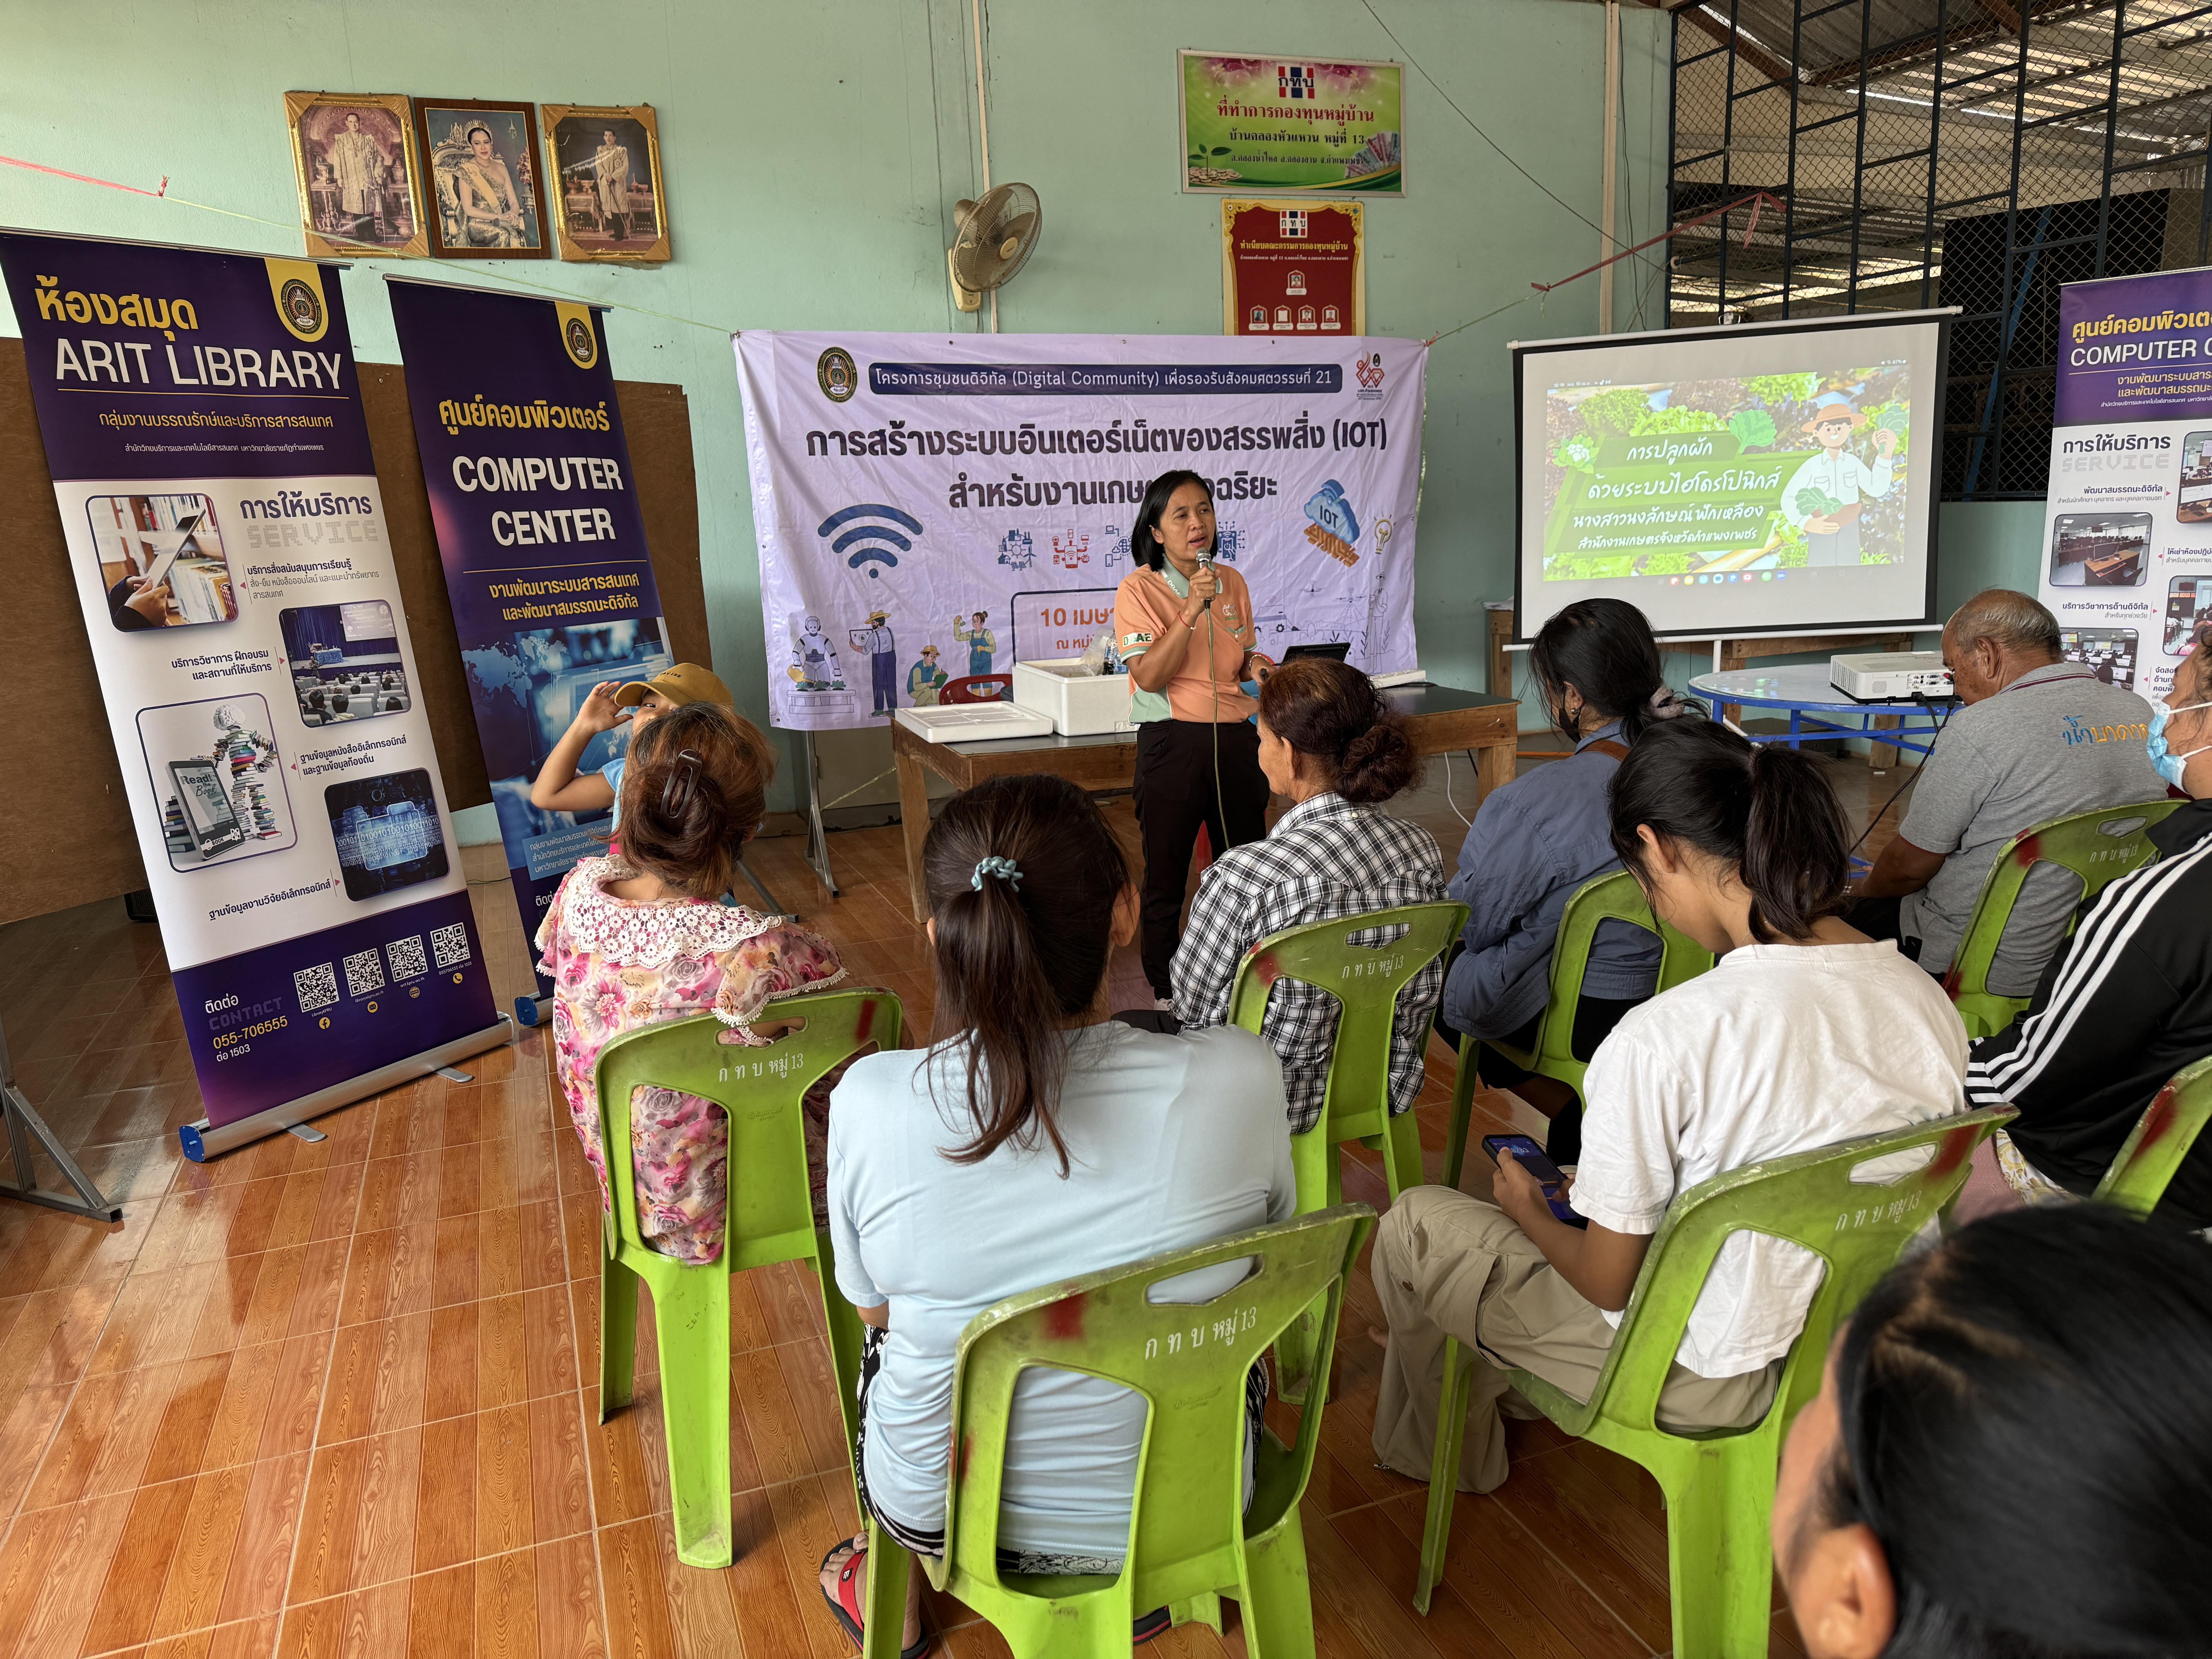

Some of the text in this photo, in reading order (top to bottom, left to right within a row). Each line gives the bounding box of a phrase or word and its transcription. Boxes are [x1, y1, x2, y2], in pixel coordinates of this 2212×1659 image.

[1278, 76, 1314, 88] กทบ
[1217, 94, 1374, 126] ที่ทำการกองทุนหมู่บ้าน
[1229, 127, 1365, 148] บ้านคลองหัวแหวน หมู่ที่ 13
[1240, 239, 1348, 252] ทำเนียบคณะกรรมการกองทุนหมู่บ้าน
[35, 275, 199, 341] ห้องสมุด
[2073, 310, 2212, 343] ศูนย์คอมพิวเต
[2071, 338, 2197, 366] COMPUTER
[56, 338, 341, 389] ARIT LIBRARY
[875, 368, 1331, 389] โครงการชุมชนดิจิทัล (Digital Community) เพื่อรองรับสังคมศตวรรษที่ 21
[2118, 371, 2212, 385] งานพัฒนาระบบสาร
[2118, 384, 2212, 397] และพัฒนาสมรรถนะ
[99, 409, 333, 430] กลุ่มงานบรรณรักษ์และบริการสารสนเทศ
[439, 394, 610, 435] ศูนย์คอมพิวเตอร์
[806, 410, 1386, 456] การสร้างระบบอินเตอร์เน็ตของสรรพสิ่ง (IOT)
[2063, 433, 2171, 453] การให้บริการ
[125, 443, 239, 452] สำนักวิทยบริการและเทคโนโลยีสารสนเทศ
[1627, 436, 1712, 465] การปลูกผัก
[2062, 453, 2169, 473] SERVICE
[452, 456, 624, 492] COMPUTER
[1588, 465, 1782, 499] ด้วยระบบไฮโดรโปนิกส์
[2084, 484, 2162, 494] พัฒนาสมรรถนะดิจิทัล
[240, 491, 372, 519] การให้บริการ
[1573, 503, 1693, 528] นางสาวนงลักษณ์
[491, 508, 616, 546] CENTER
[1320, 504, 1339, 529] IOT
[247, 520, 379, 548] SERVICE
[1578, 527, 1758, 550] สำนักงานเกษตรจังหวัดกำแพงเพชร
[247, 558, 352, 575] บริการสิ่งสนับสนุนการเรียนรู้
[320, 571, 380, 583] และแนะนำทรัพยากร
[253, 590, 284, 599] สารสนเทศ
[489, 573, 640, 598] งานพัฒนาระบบสารสนเทศ
[503, 592, 639, 620] และพัฒนาสมรรถนะดิจิทัล
[1040, 607, 1115, 627] 10 เมษ
[1056, 639, 1069, 649] ณ
[1123, 633, 1152, 646] DAE
[172, 650, 269, 668] บริการวิชาการ ฝึกอบรม
[192, 663, 272, 680] และสถานที่ให้บริการ
[300, 734, 407, 764] ฐานข้อมูลหนังสืออิเล็กทรอนิกส์
[303, 753, 374, 775] และฐานข้อมูลท้องถิ่น
[180, 774, 213, 785] Read!
[196, 784, 217, 797] Book
[212, 837, 224, 846] BOOK
[209, 879, 331, 921] ฐานข้อมูลงานวิจัยอิเล็กทรอนิกส์
[535, 891, 556, 907] ติดต่
[1342, 966, 1350, 979] ก
[1355, 964, 1363, 977] ท
[205, 993, 239, 1013] ติดต่อ
[209, 997, 282, 1030] CONTACT
[213, 1015, 288, 1049] 055-706555
[216, 1044, 251, 1062] ต่อ 1503
[719, 1067, 727, 1082] ก
[735, 1065, 746, 1080] ท
[752, 1062, 763, 1077] บ
[1146, 1337, 1157, 1360] ก
[1167, 1332, 1181, 1354] ท
[1191, 1326, 1205, 1348] บ
